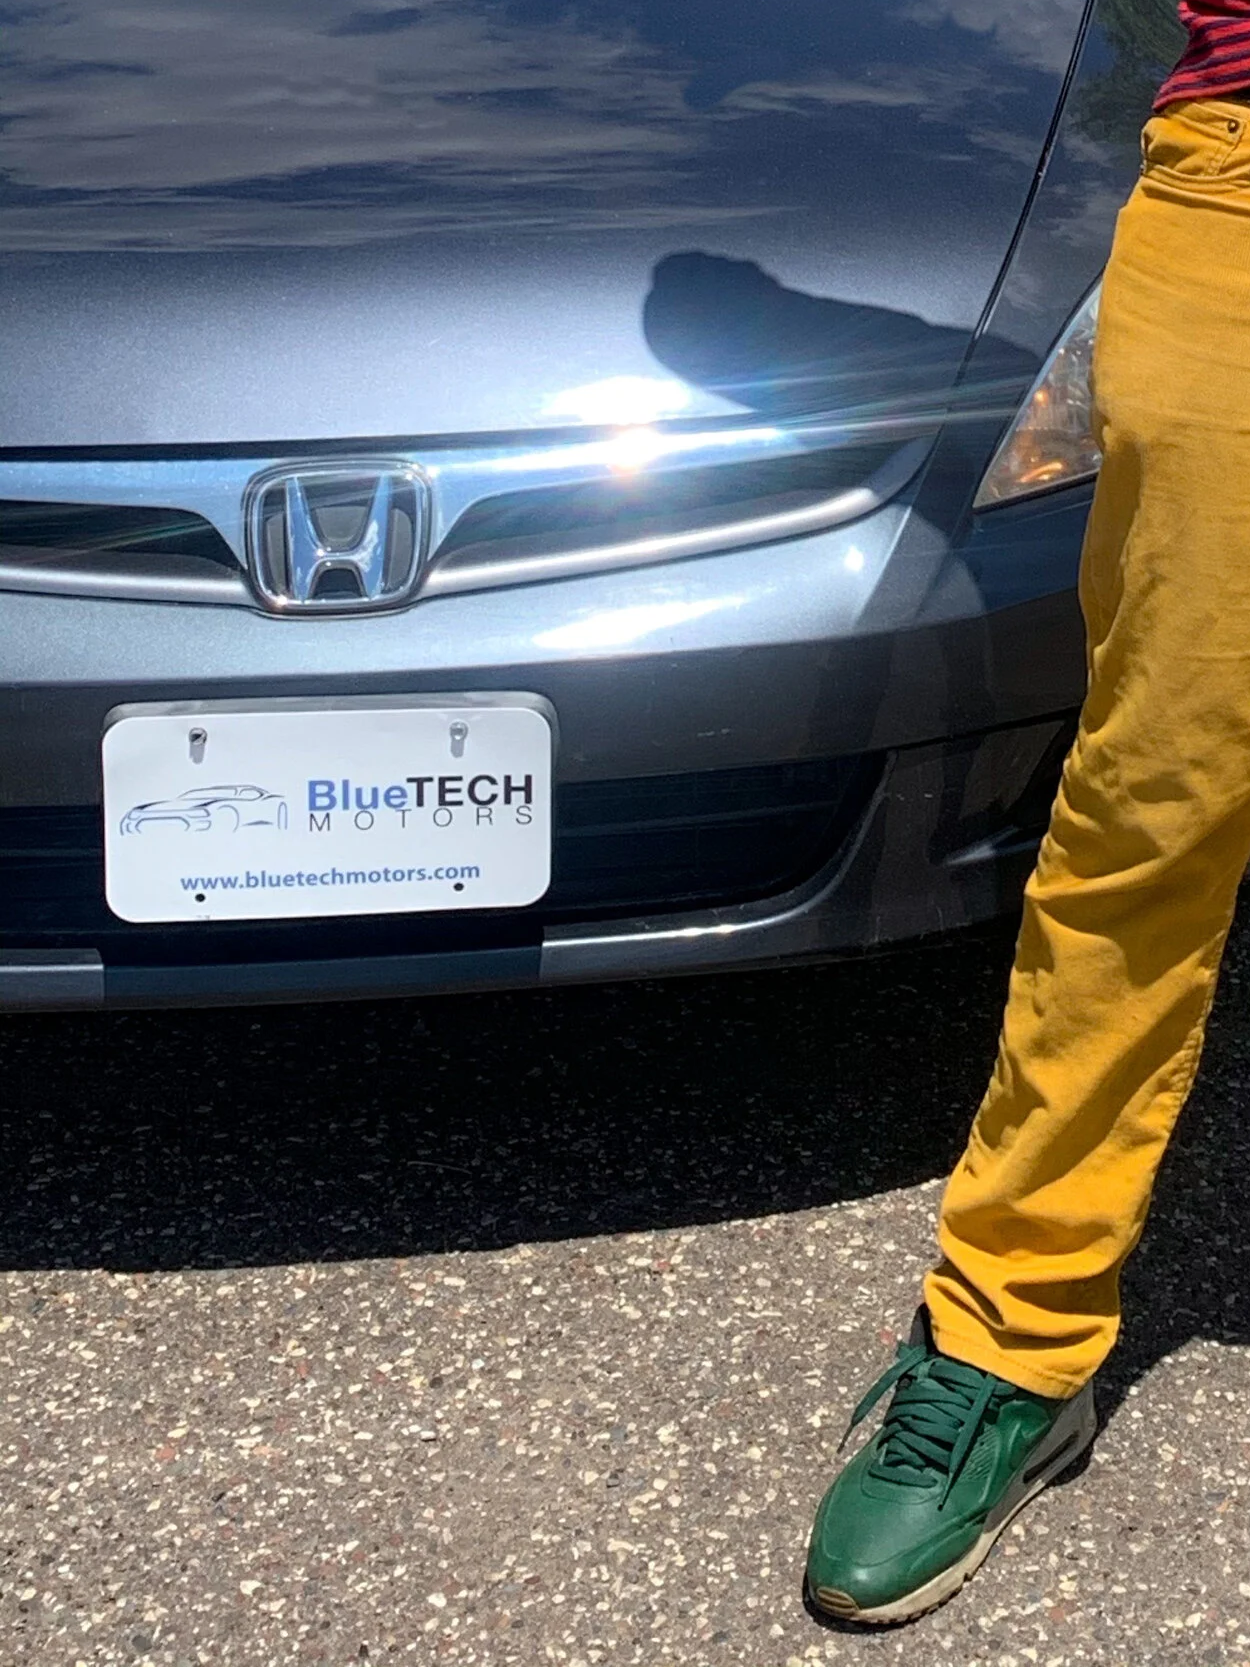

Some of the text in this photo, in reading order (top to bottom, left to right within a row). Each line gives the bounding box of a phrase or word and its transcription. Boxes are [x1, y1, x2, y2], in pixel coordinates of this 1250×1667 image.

[307, 774, 534, 812] BlueTECH
[309, 805, 533, 832] MOTORS
[180, 864, 481, 891] www.bluetechmotors.com
